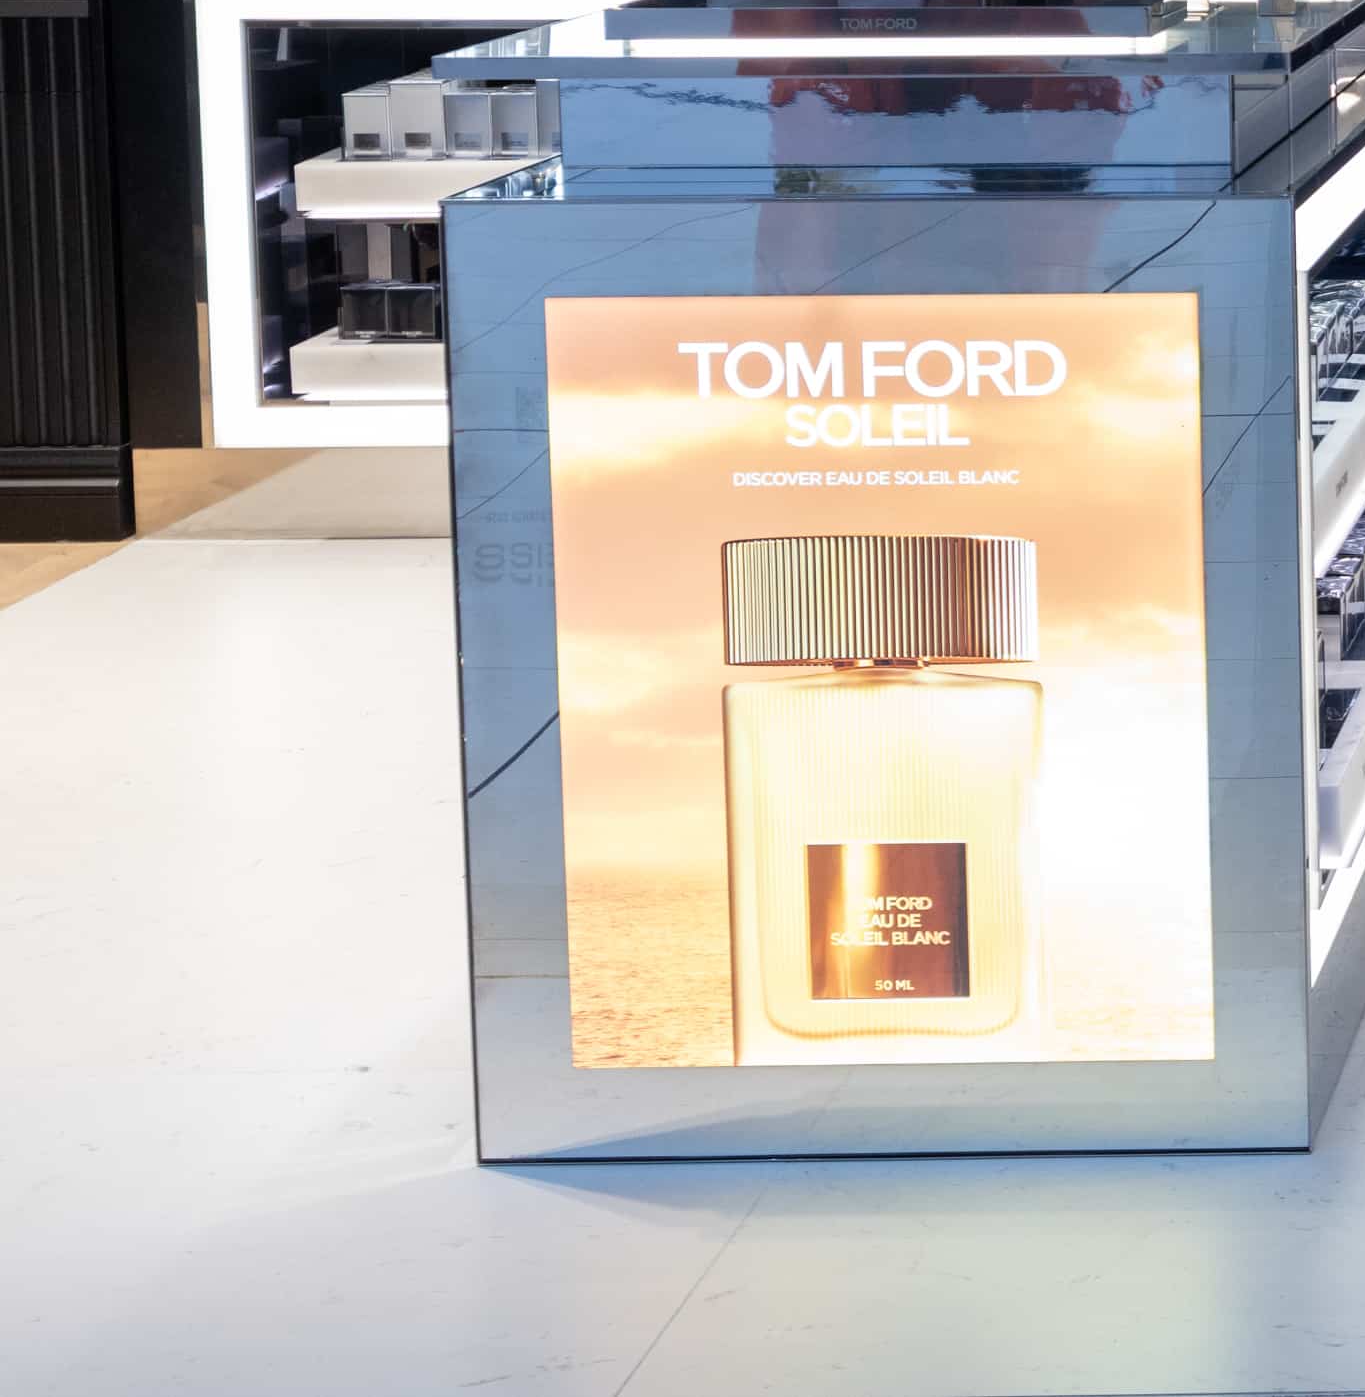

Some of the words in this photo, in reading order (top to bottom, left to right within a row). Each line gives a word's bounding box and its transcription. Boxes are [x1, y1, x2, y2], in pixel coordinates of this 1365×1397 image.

[840, 18, 872, 30] TOM
[876, 18, 918, 30] FORD
[678, 341, 845, 399] TOM
[861, 339, 1067, 398] FORD
[785, 403, 970, 447] SOLEIL
[733, 470, 822, 486] DISCOVER
[826, 470, 863, 486] EAU
[866, 470, 891, 485] DE
[894, 470, 954, 485] SOLEIL
[958, 469, 1019, 485] BLANC
[886, 896, 933, 911] FORD
[897, 914, 922, 928] DE
[892, 931, 951, 946] BLANC
[875, 979, 893, 991] 50
[895, 979, 915, 991] ML
